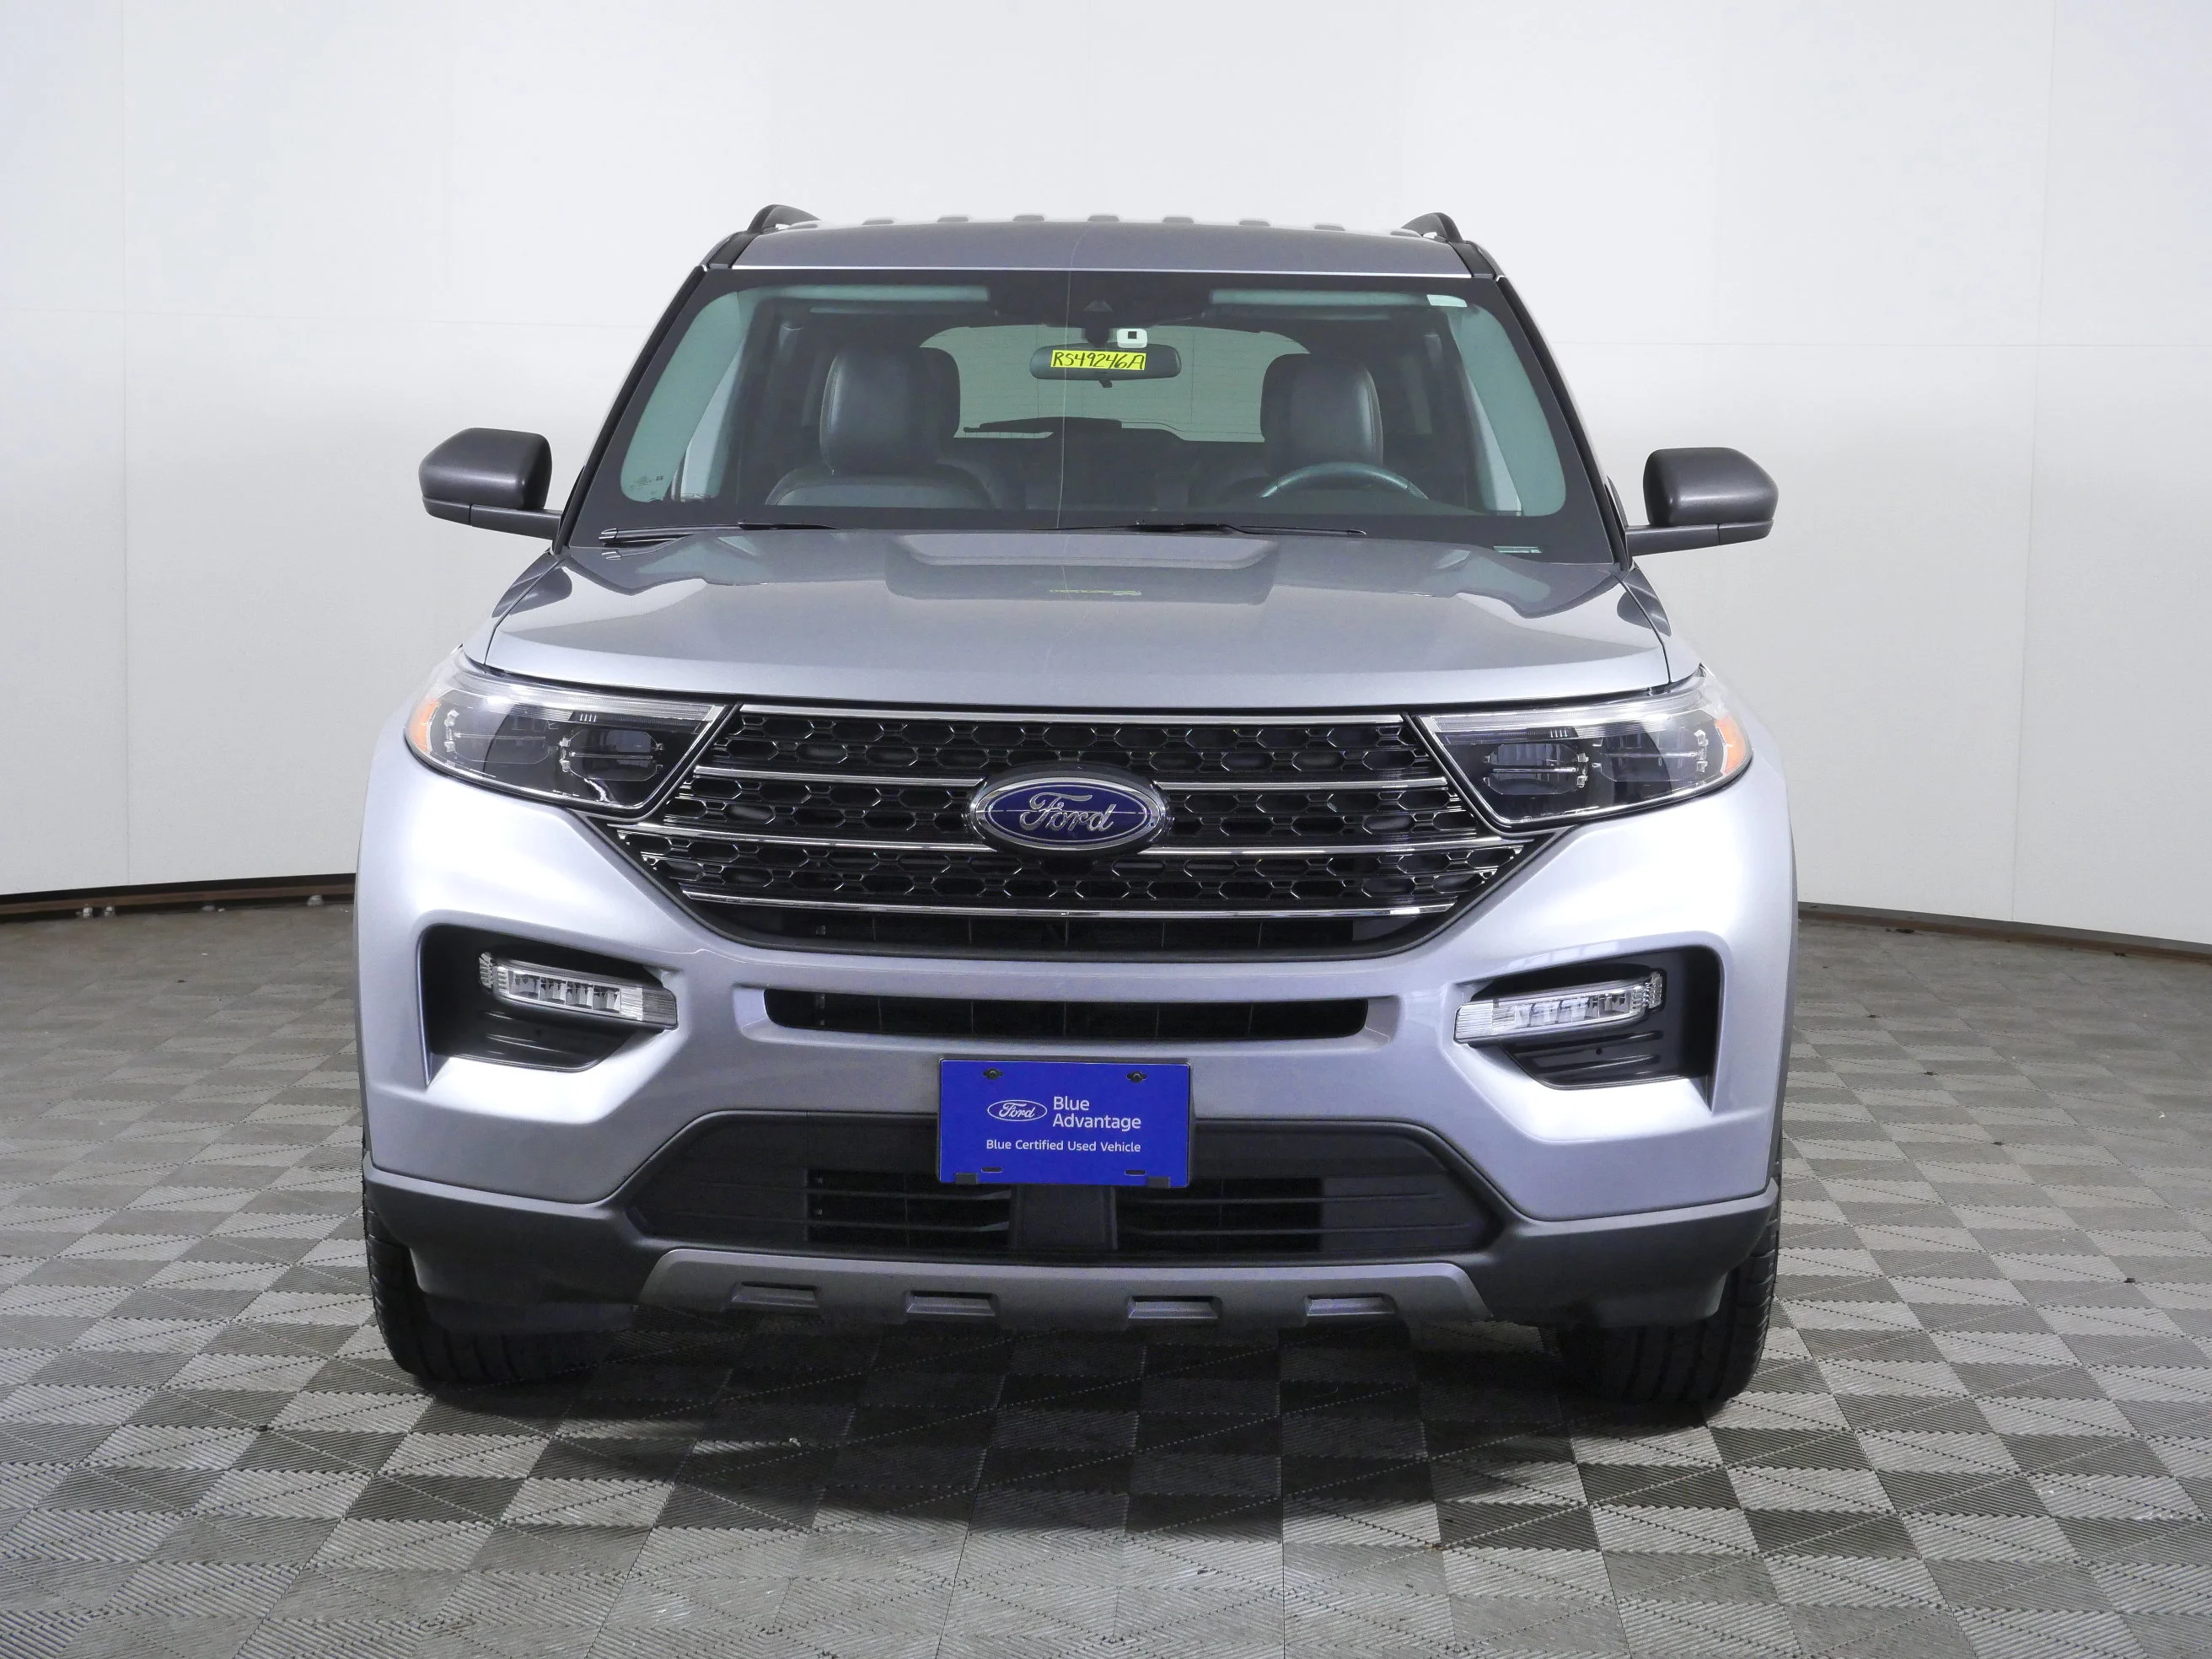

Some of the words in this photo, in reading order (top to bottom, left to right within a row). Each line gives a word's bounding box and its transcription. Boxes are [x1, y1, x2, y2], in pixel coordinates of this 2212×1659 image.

[1019, 792, 1117, 831] Ford
[998, 1103, 1035, 1119] Ford
[1054, 1096, 1090, 1111] Blue
[1053, 1114, 1141, 1131] Advantage
[986, 1140, 1012, 1151] Blue
[1015, 1140, 1064, 1151] Certified
[1067, 1141, 1097, 1152] Used
[1100, 1141, 1141, 1152] Vehicle
